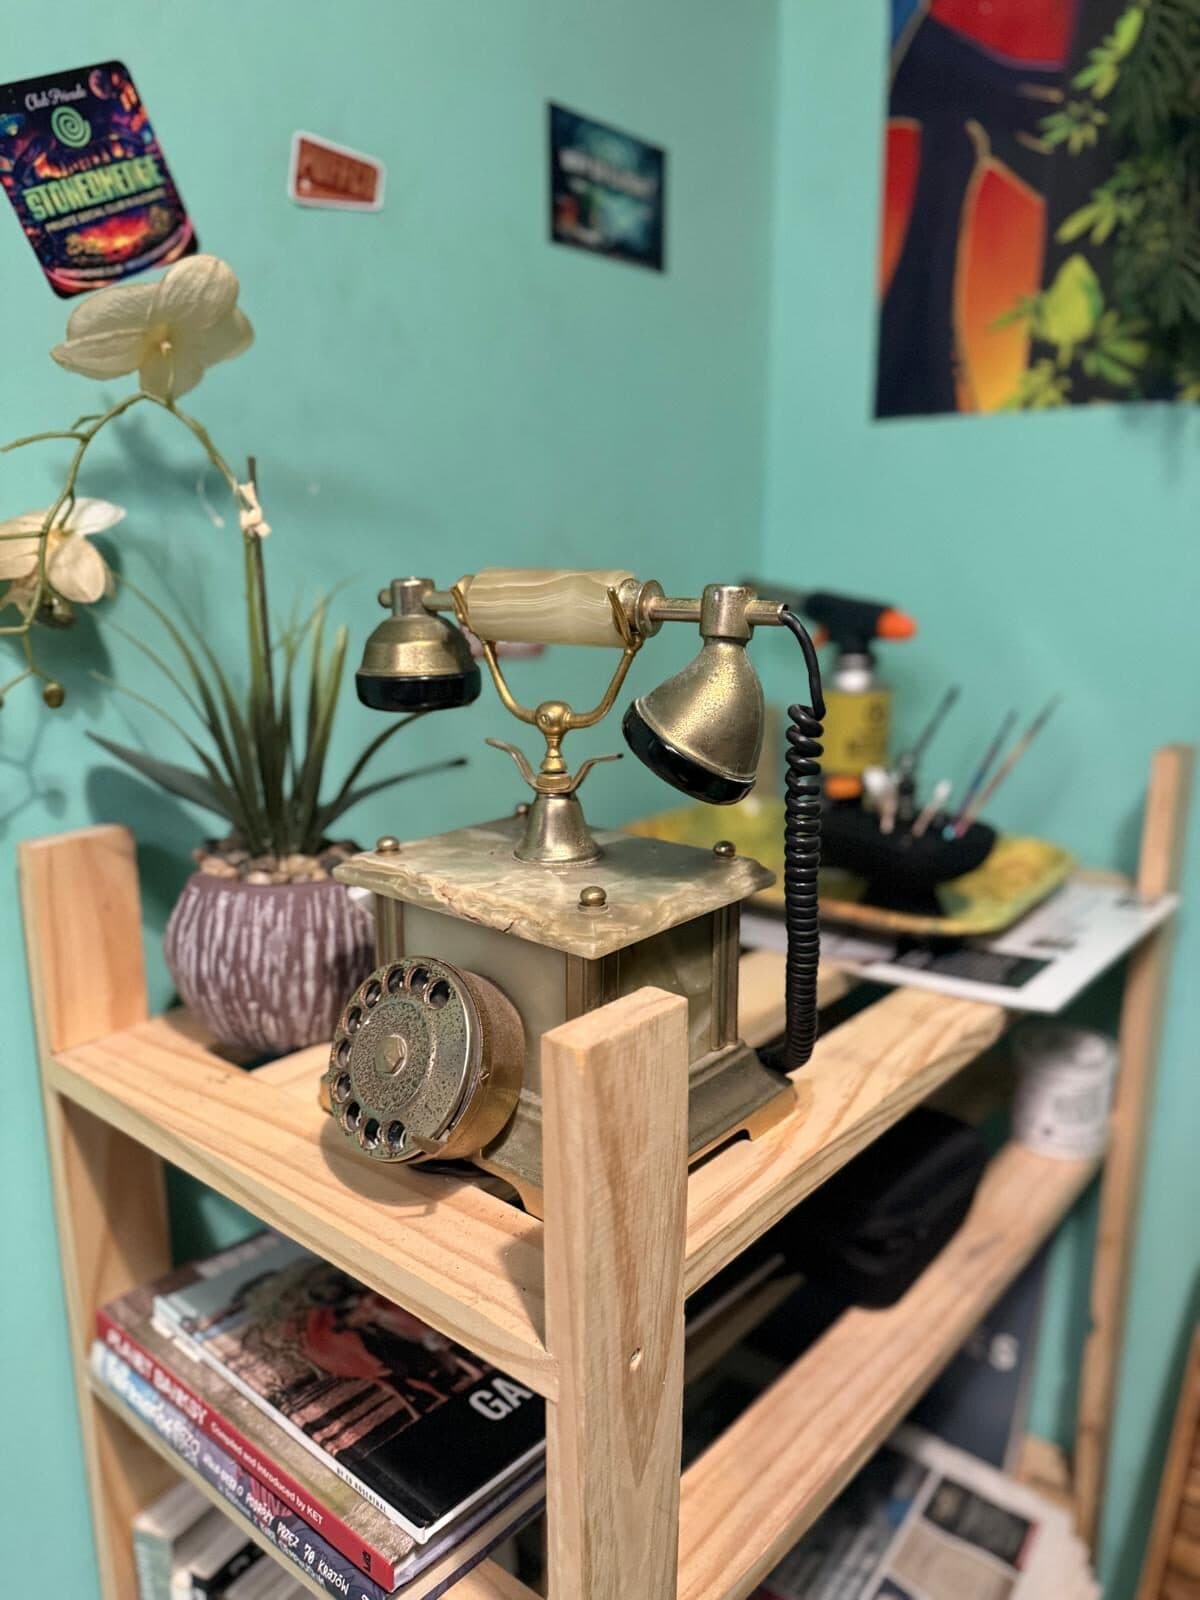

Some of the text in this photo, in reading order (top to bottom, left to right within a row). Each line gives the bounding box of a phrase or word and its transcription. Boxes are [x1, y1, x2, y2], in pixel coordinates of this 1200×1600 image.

[296, 1495, 306, 1512] by
[306, 1503, 324, 1525] KET
[303, 1543, 314, 1565] 70
